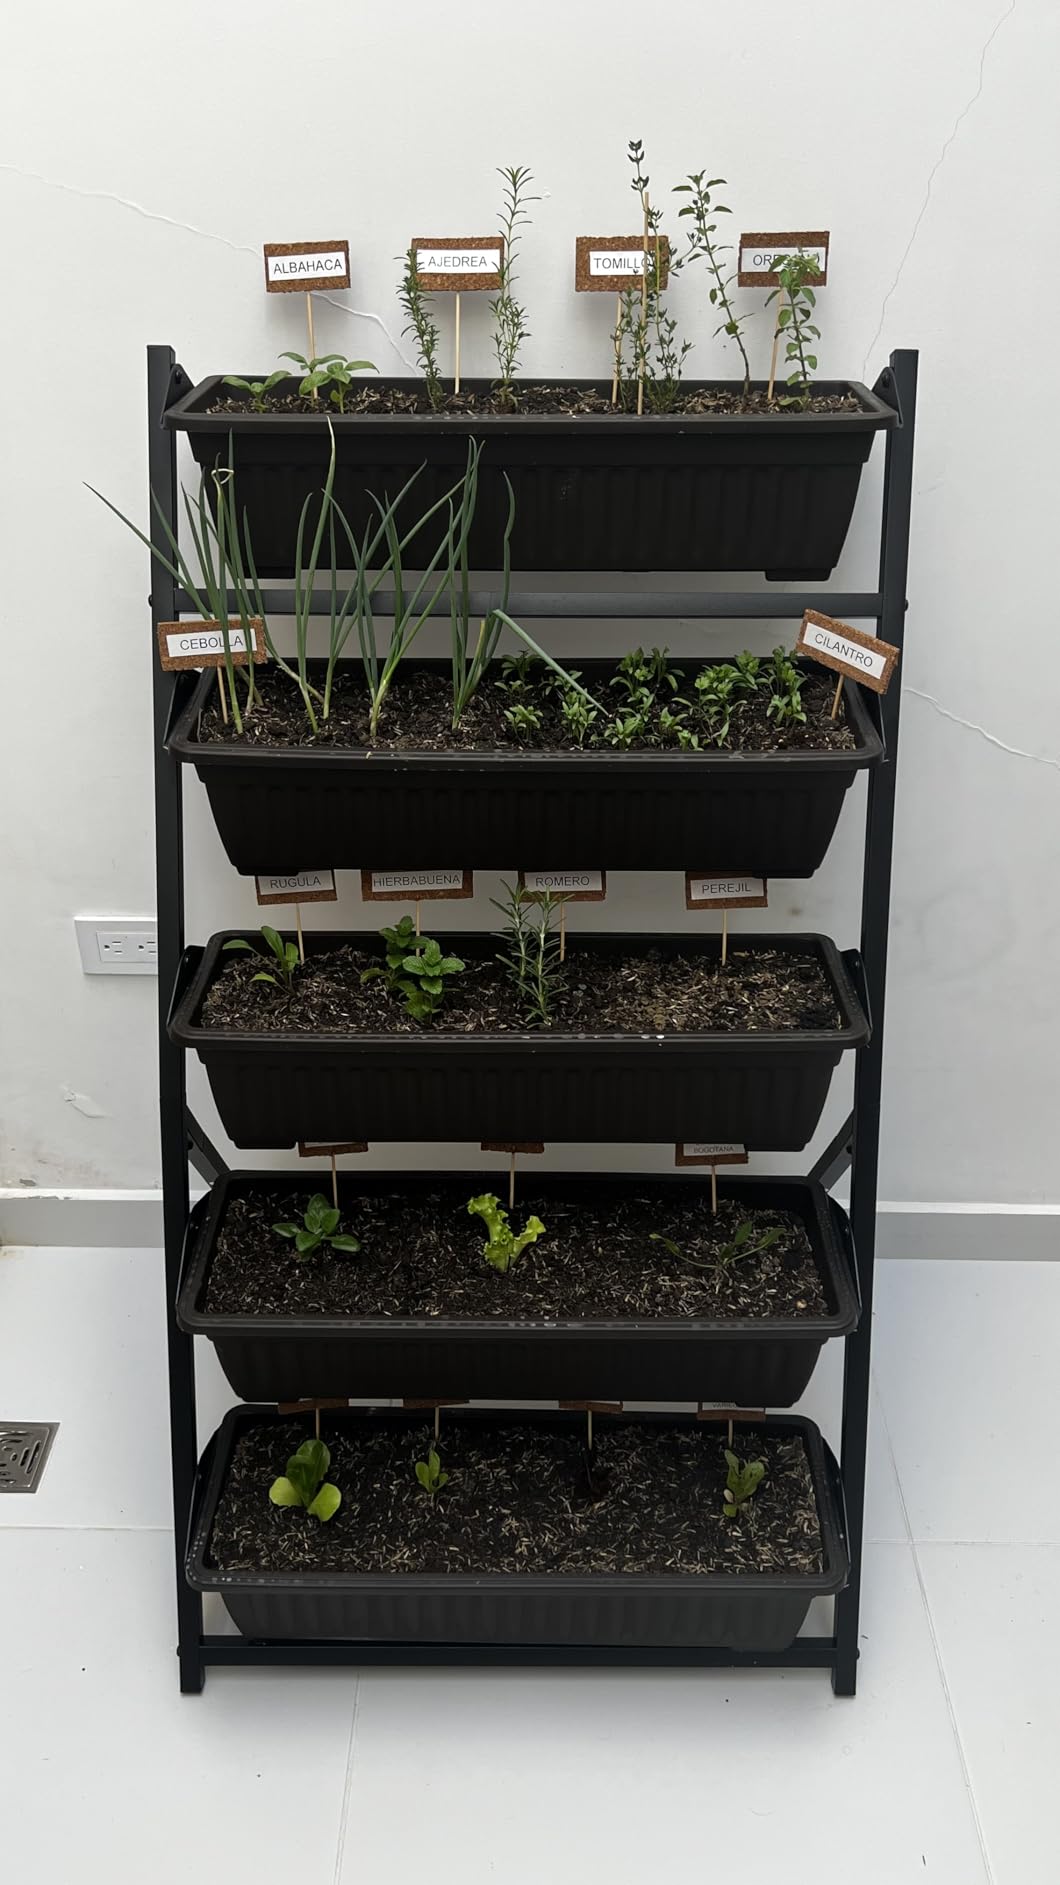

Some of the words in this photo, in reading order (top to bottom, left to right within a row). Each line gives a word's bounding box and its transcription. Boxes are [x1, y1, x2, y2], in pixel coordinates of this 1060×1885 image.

[273, 258, 343, 274] ALBAHACA
[428, 256, 487, 268] AJEDREA
[180, 635, 243, 650] CEBOLA
[815, 633, 873, 668] CILANTRO
[270, 876, 321, 889] RUGULA
[373, 875, 460, 887] HIERBABUENA
[536, 875, 590, 887] ROMERO
[702, 882, 751, 894] PEREJIL
